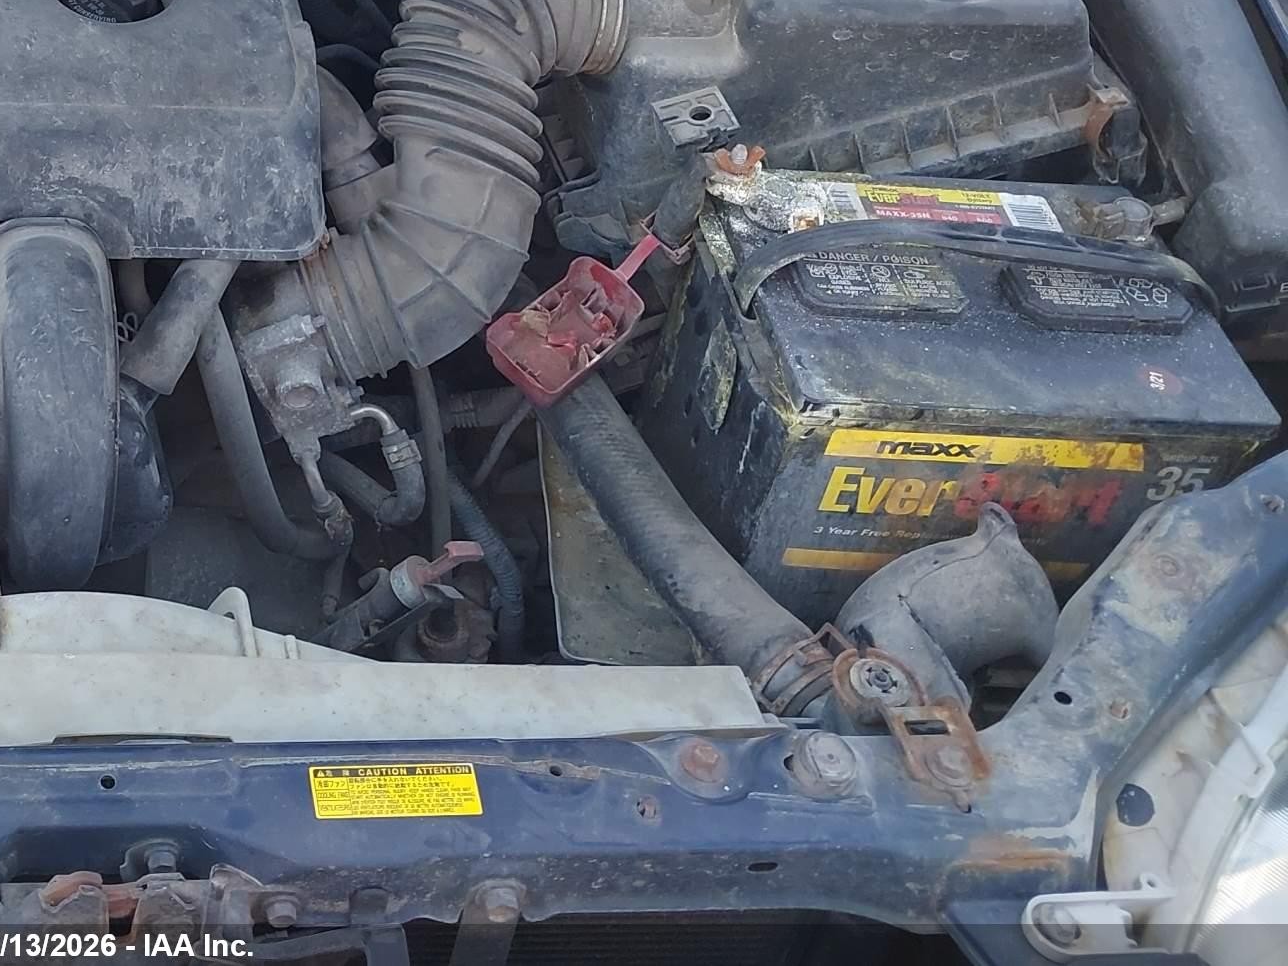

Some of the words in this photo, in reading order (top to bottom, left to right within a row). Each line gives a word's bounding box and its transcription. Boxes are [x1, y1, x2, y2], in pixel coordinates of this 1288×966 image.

[819, 251, 870, 262] DANGER
[882, 254, 929, 265] POISON
[876, 440, 981, 459] maxx
[1146, 466, 1211, 501] 35
[813, 526, 824, 534] 3
[827, 526, 858, 536] Year
[861, 529, 891, 537] Free
[358, 767, 407, 776] CAUTION
[415, 766, 469, 775] ATTENTION
